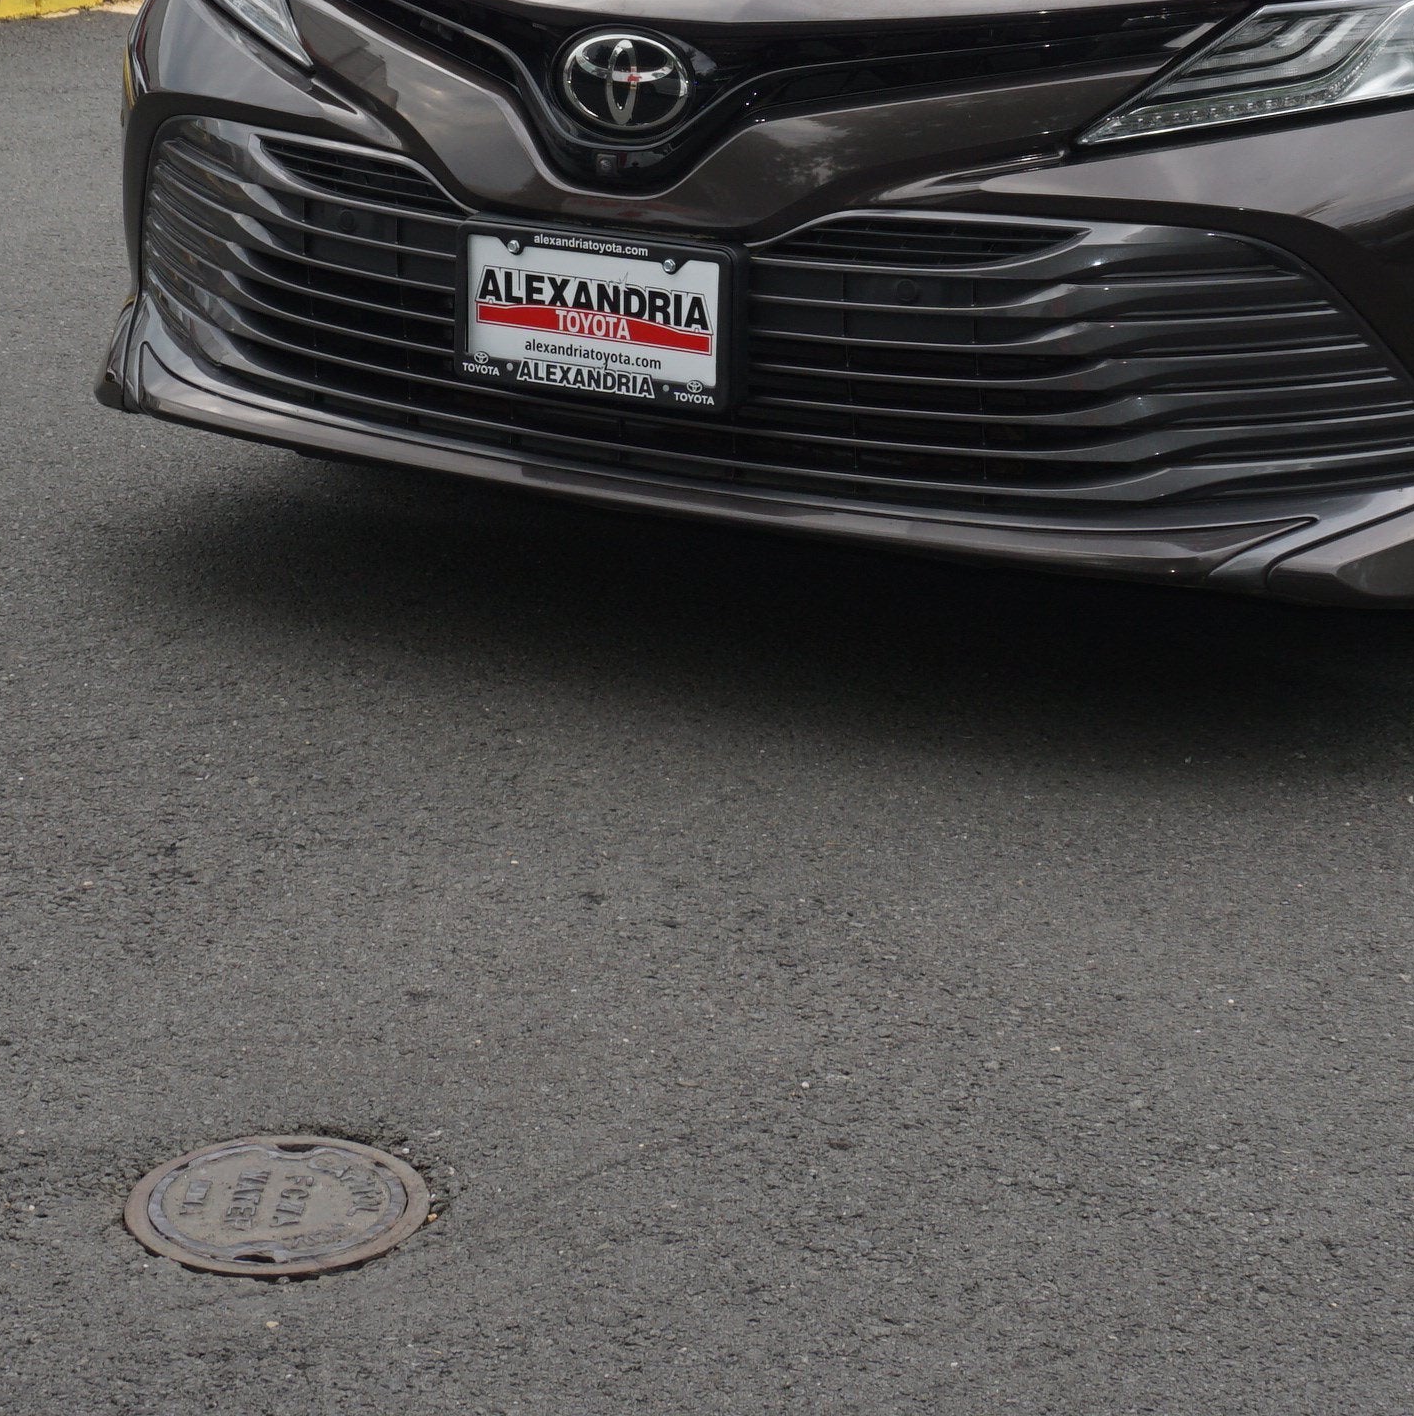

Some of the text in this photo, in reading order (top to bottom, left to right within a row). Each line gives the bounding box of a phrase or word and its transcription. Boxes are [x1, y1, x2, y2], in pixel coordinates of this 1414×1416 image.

[534, 234, 649, 257] alexandriatoyota.com
[477, 267, 711, 332] ALEXANDRIA
[555, 309, 631, 341] TOYOTA
[462, 362, 500, 377] TOYOTA
[525, 338, 662, 370] alexandriatoyota.com
[517, 358, 655, 399] ALEXANDRIA
[674, 391, 715, 406] TOYOTA
